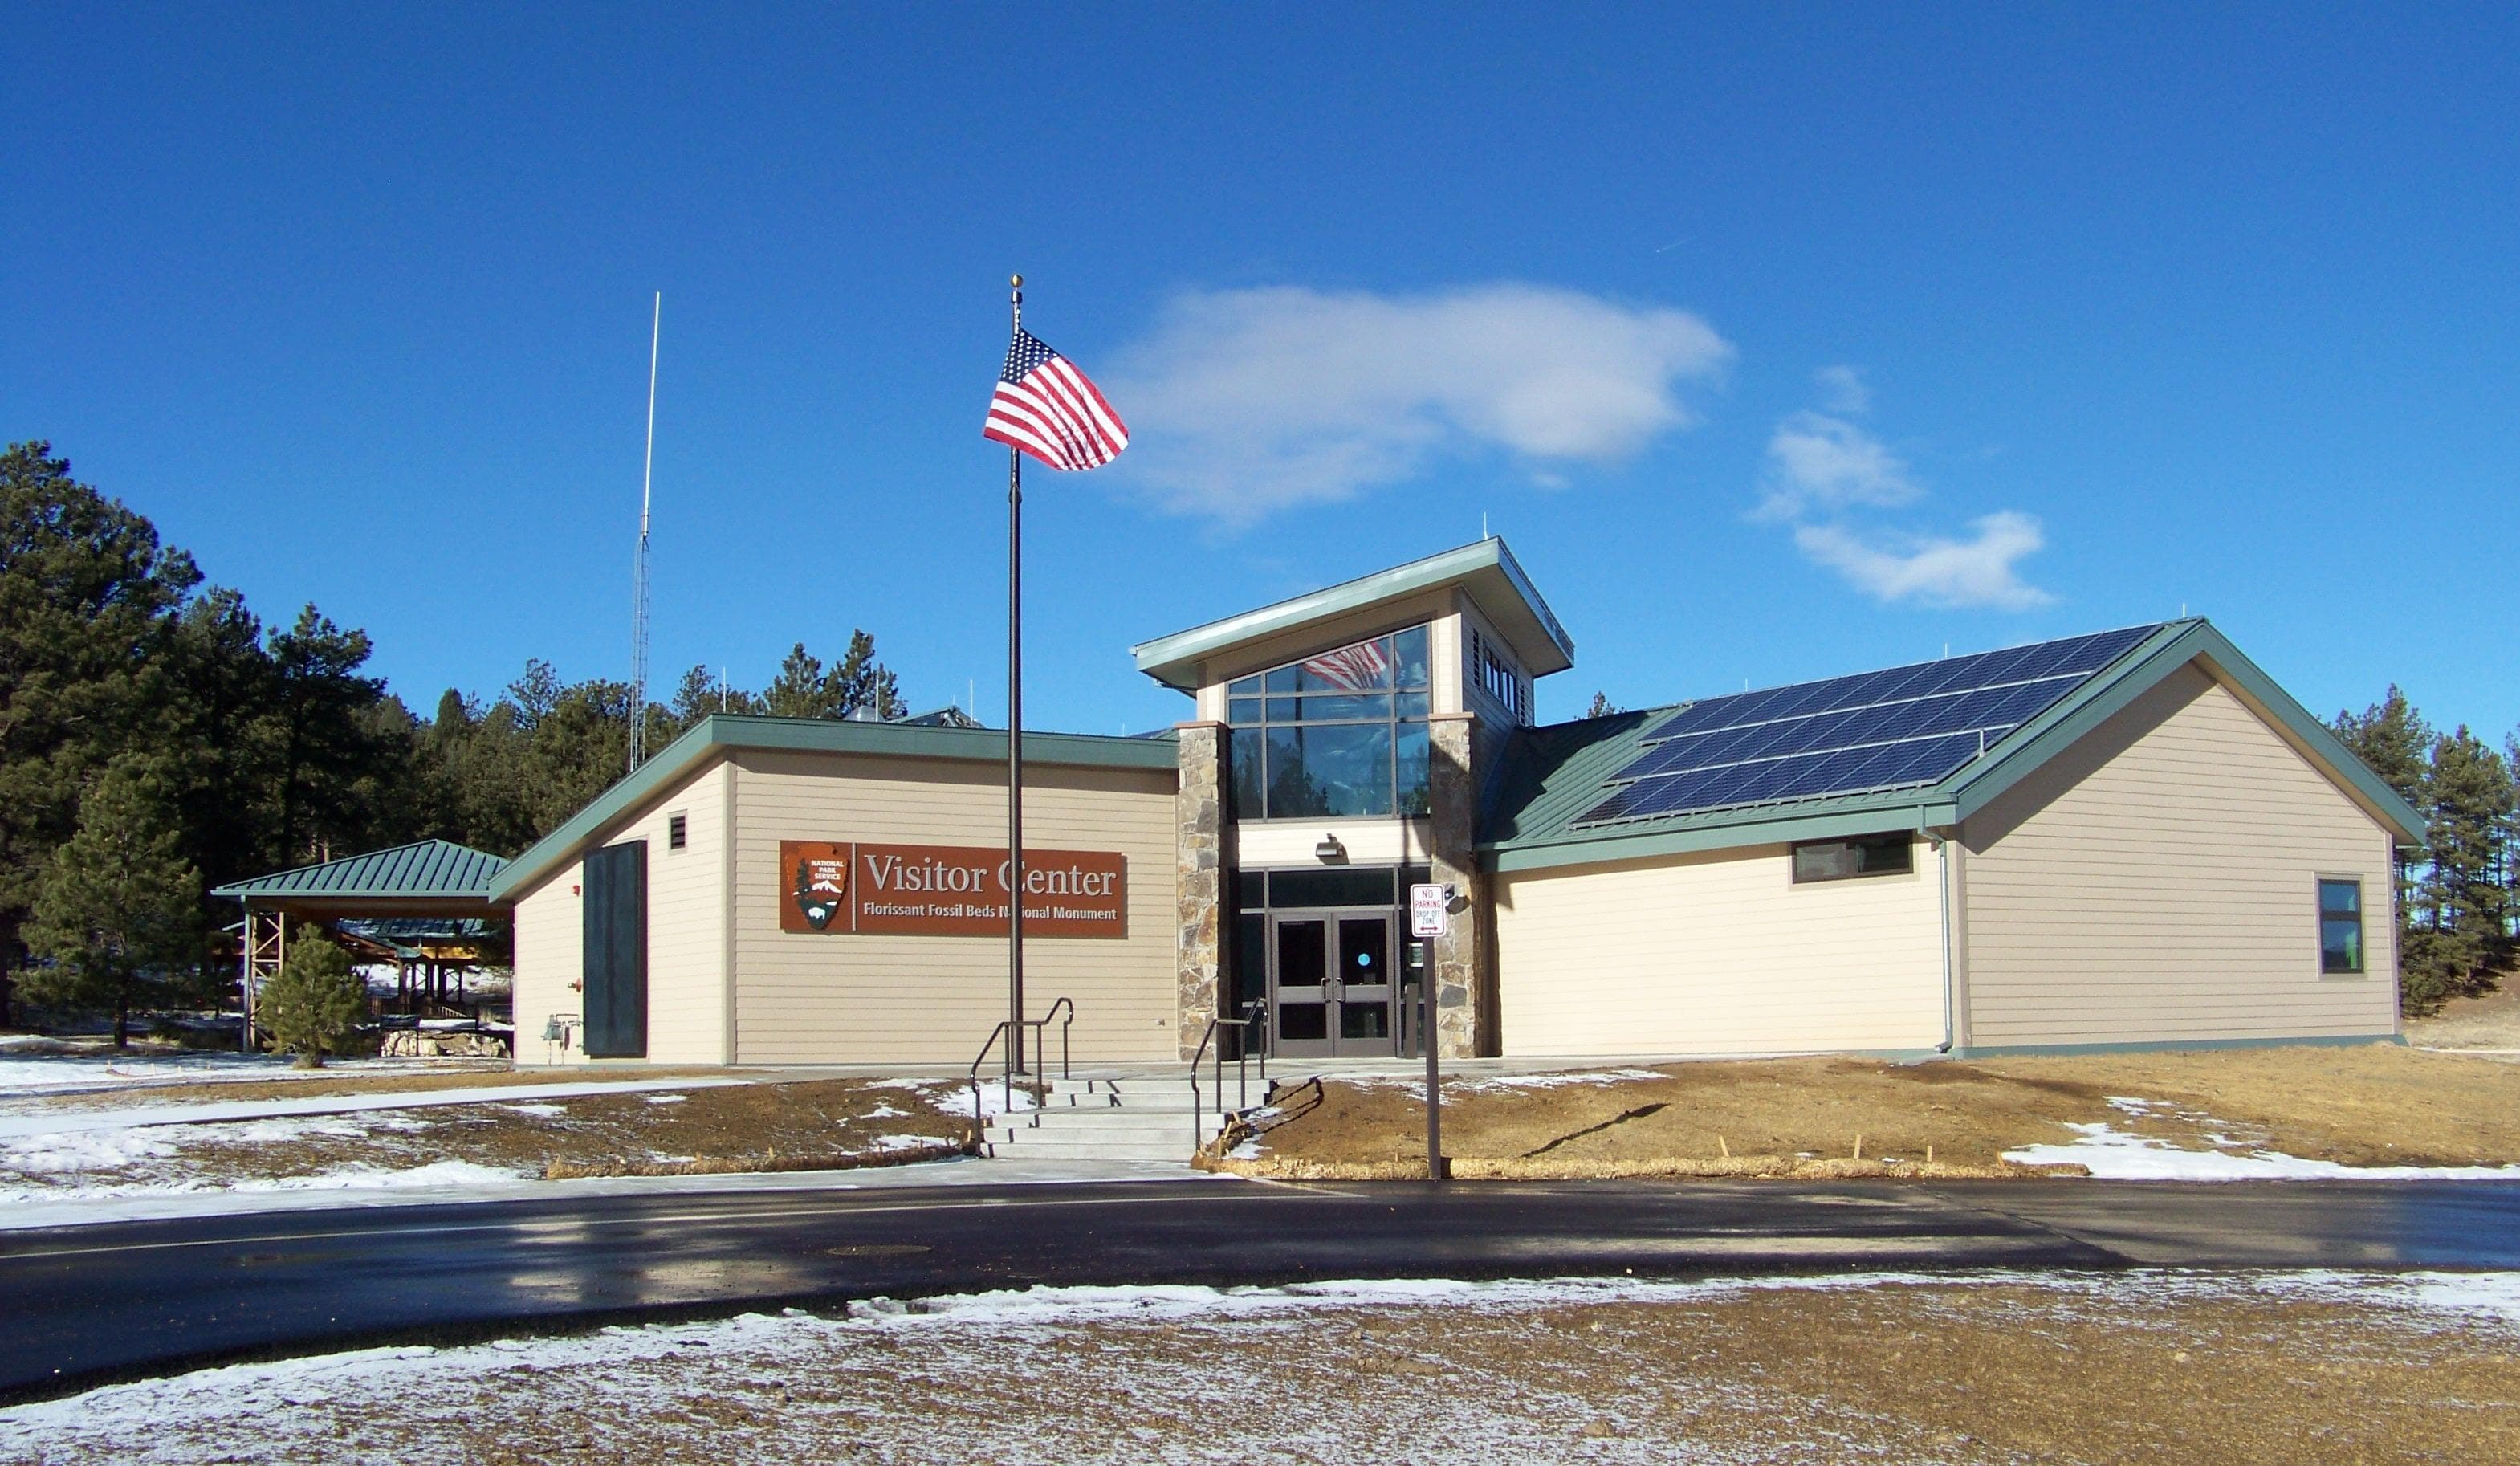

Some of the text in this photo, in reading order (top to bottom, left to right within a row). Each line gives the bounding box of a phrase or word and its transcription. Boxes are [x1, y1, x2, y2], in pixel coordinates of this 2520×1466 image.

[864, 854, 987, 893] Visitor
[1422, 890, 1434, 898] NO
[864, 902, 1117, 920] Florissant Fossil Beds Nional Monument
[1415, 899, 1441, 909] PARKING
